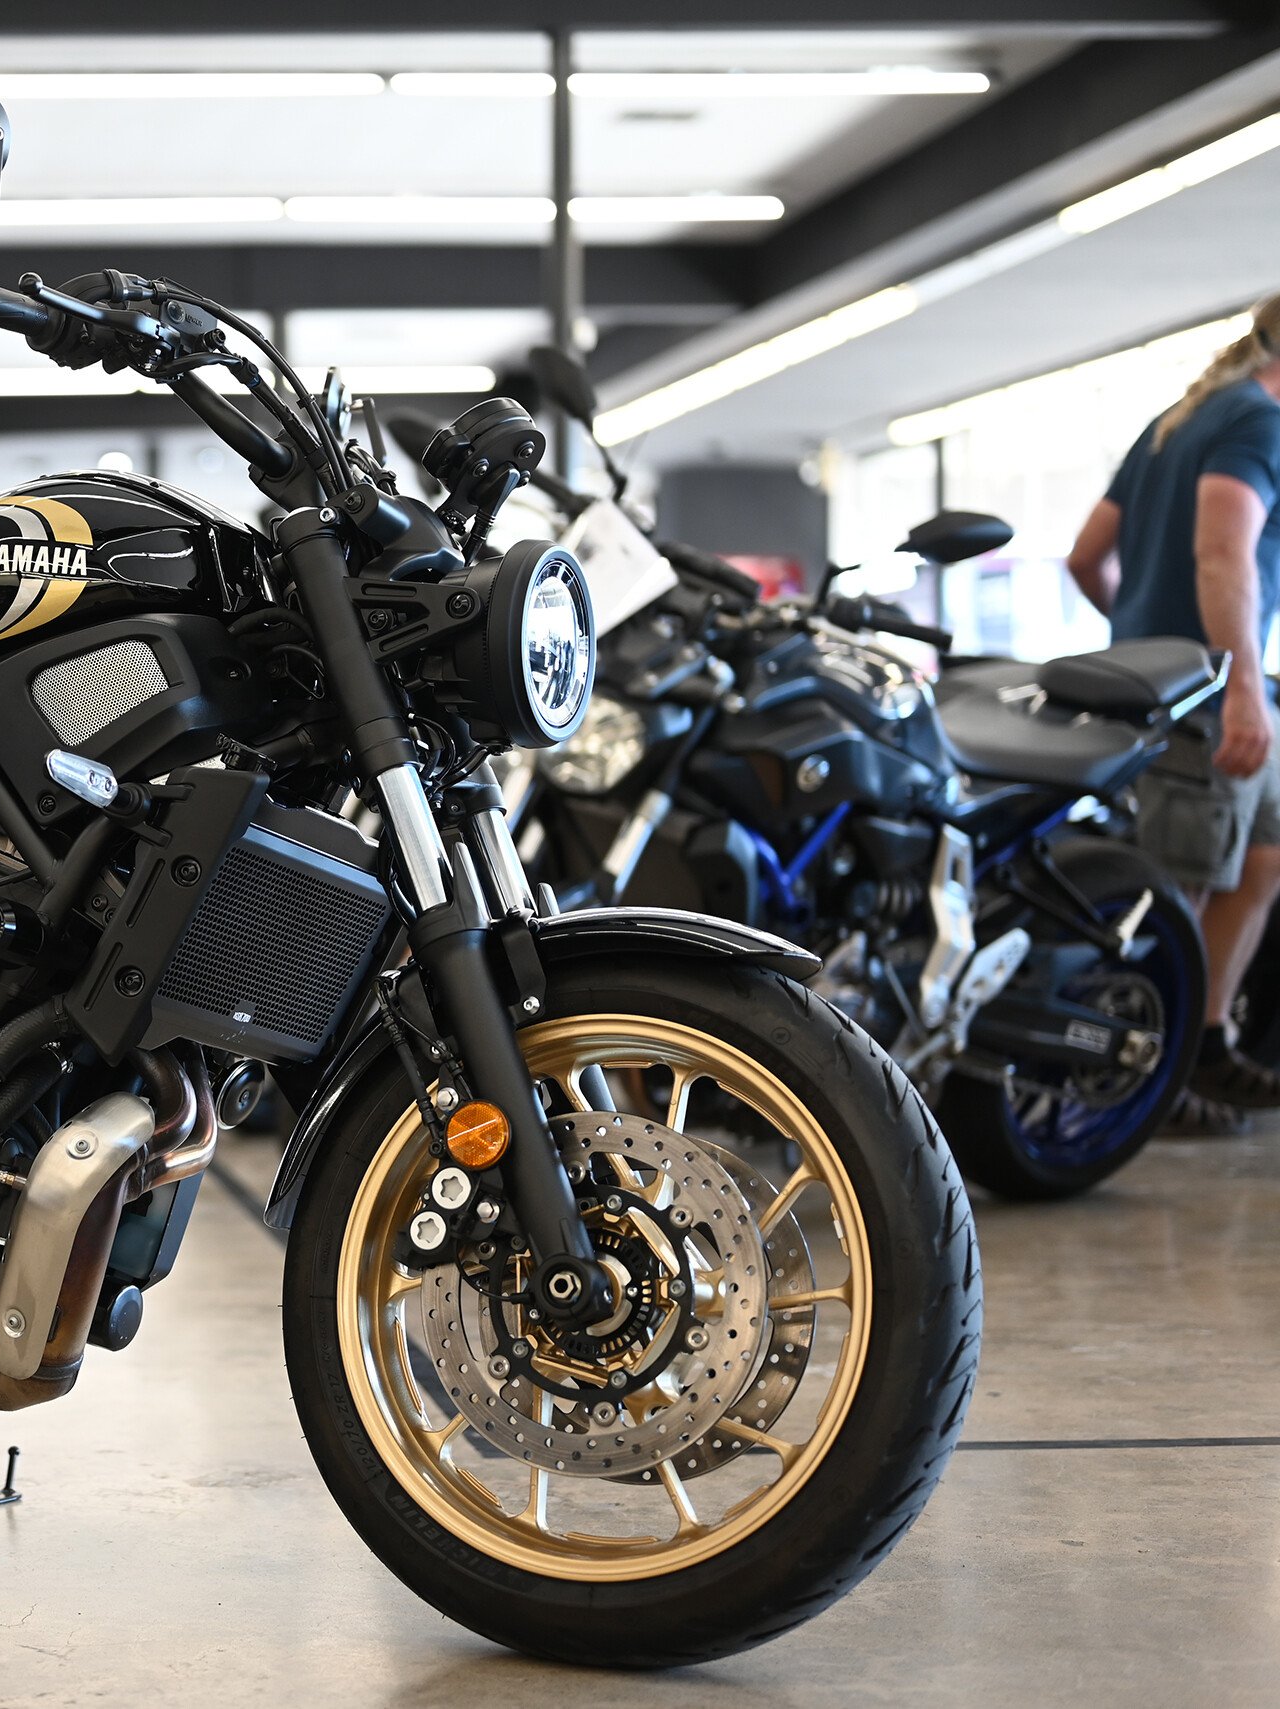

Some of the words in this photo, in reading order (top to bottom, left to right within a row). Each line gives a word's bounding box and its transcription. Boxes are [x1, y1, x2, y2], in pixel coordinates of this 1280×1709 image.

[326, 1371, 340, 1388] 17
[333, 1393, 349, 1415] ZR
[341, 1417, 377, 1471] 120/70
[389, 1492, 502, 1578] MICHELIN
